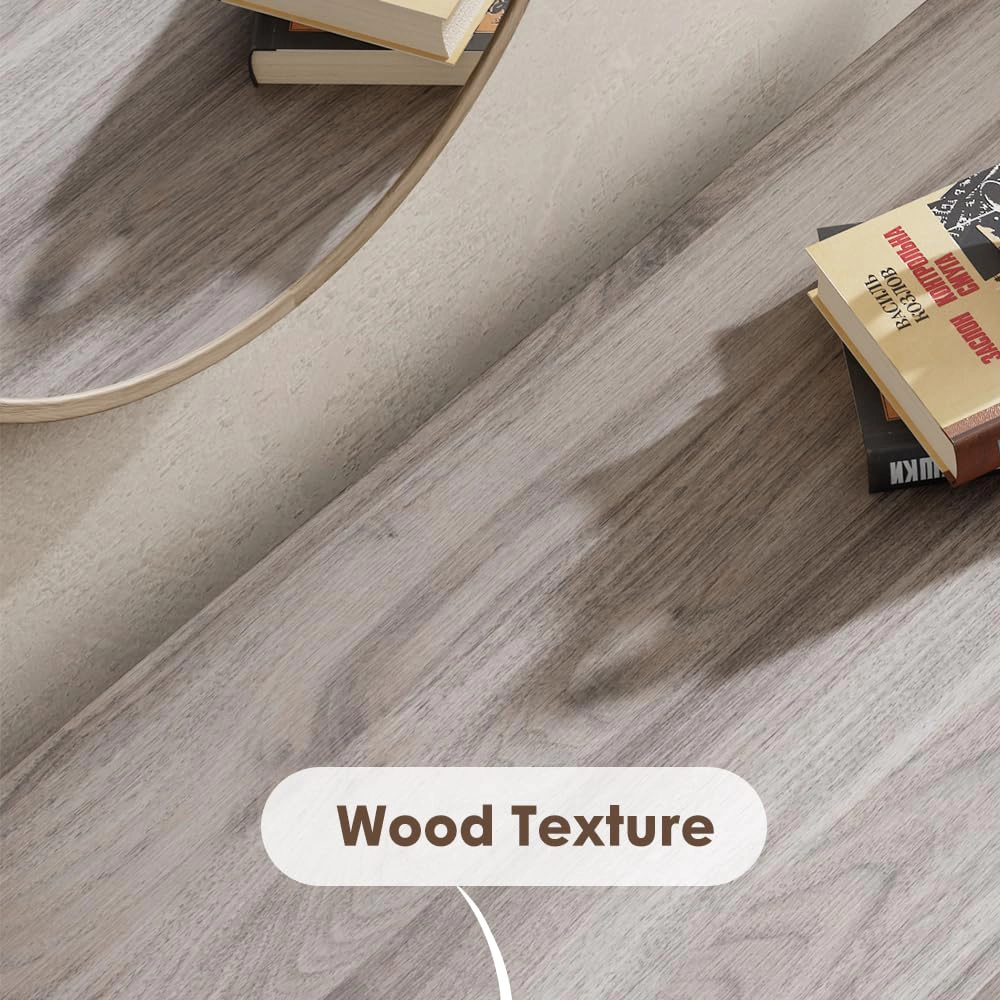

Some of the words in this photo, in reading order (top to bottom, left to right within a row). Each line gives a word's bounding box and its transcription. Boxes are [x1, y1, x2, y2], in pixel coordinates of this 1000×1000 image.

[883, 225, 958, 308] КОНТРОЛЬНА
[934, 252, 980, 297] СМУГА
[864, 274, 912, 331] ВАСИЛЬ
[880, 267, 930, 323] КОЗЛОВ
[890, 456, 944, 486] ШКИ
